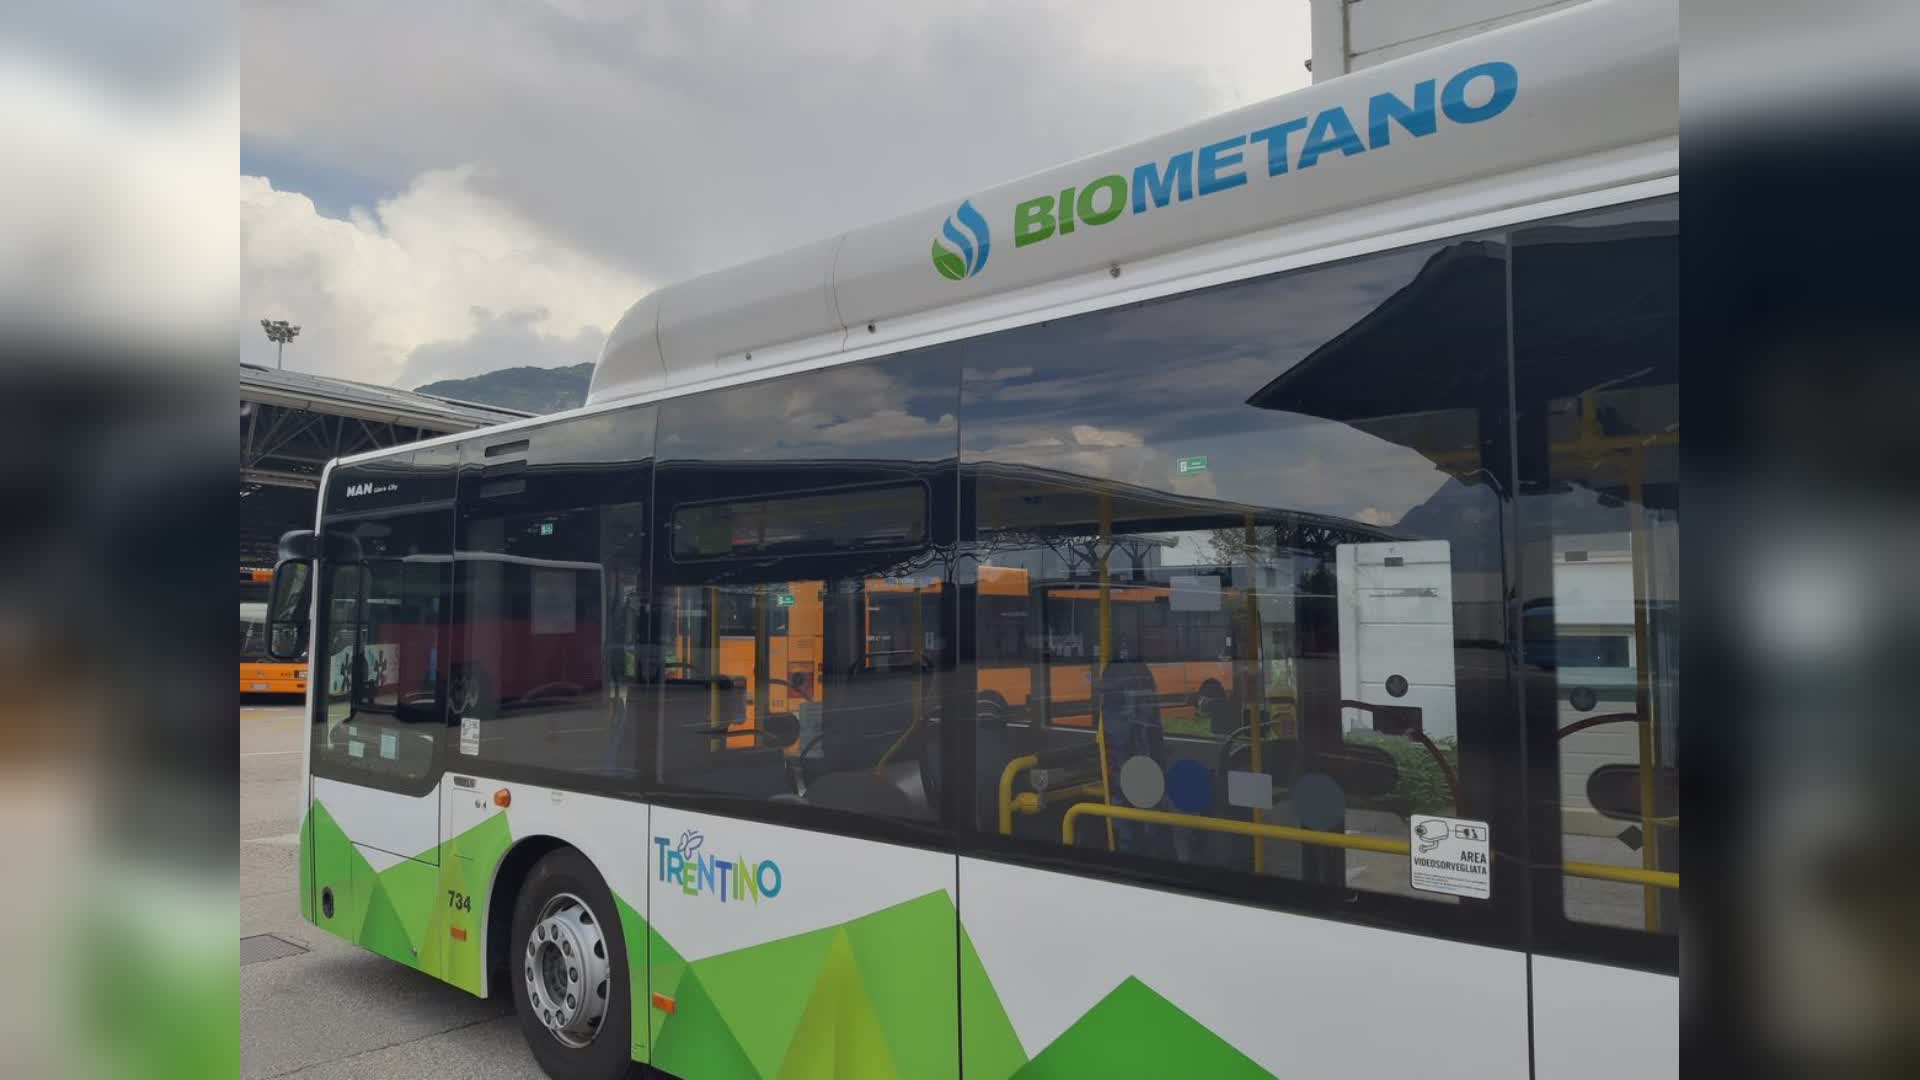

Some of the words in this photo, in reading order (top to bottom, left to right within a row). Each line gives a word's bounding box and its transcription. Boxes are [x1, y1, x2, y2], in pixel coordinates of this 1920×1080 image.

[1014, 61, 1519, 249] BIOMETANO
[346, 482, 373, 498] MAN
[1414, 857, 1487, 875] VIDEOSORVEGLIATA
[1460, 850, 1487, 865] AREA
[654, 836, 782, 905] TRENTINO
[447, 889, 472, 913] 734
